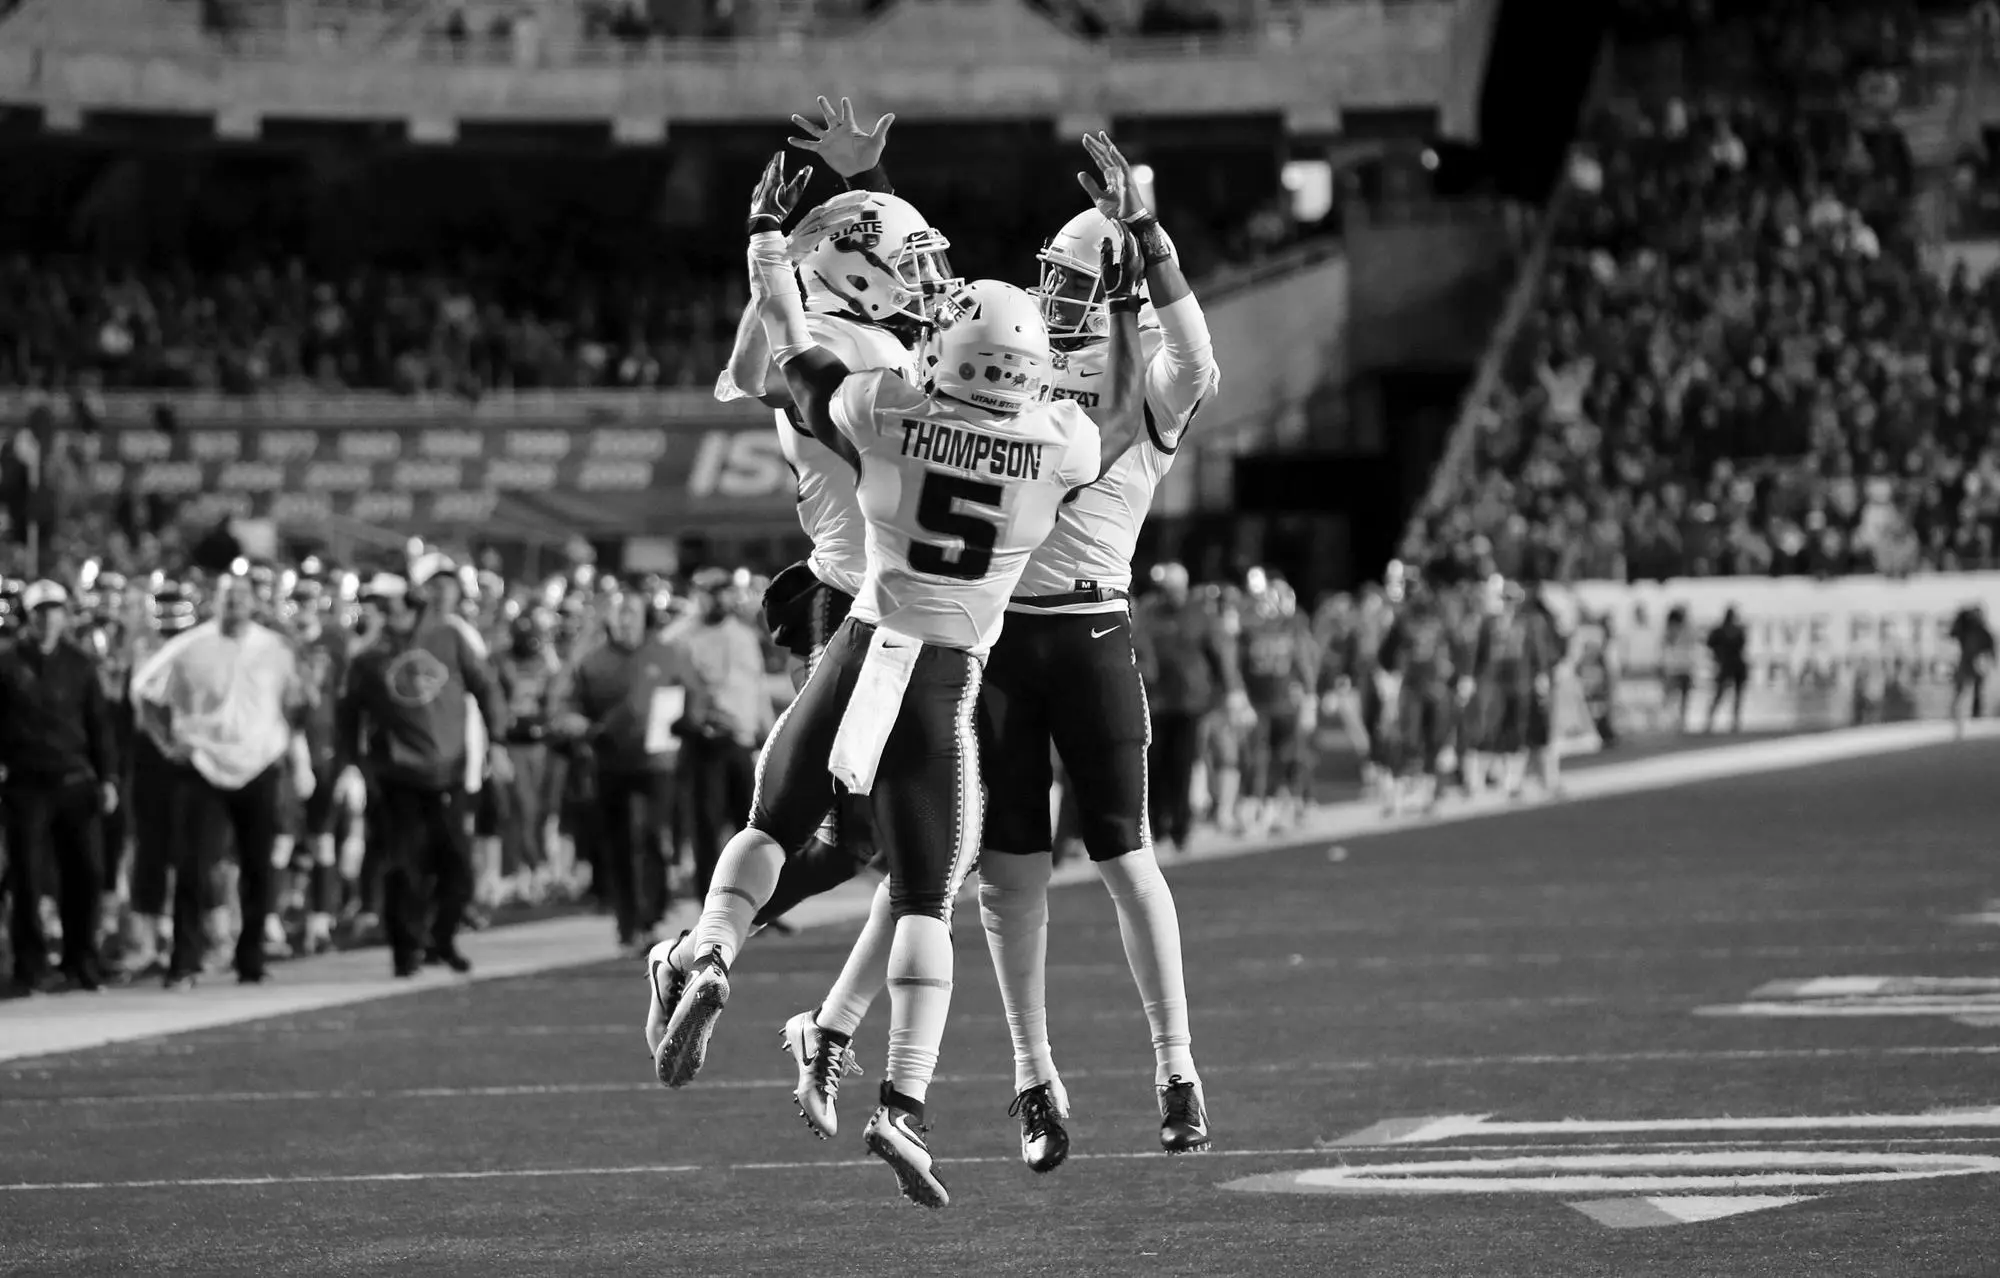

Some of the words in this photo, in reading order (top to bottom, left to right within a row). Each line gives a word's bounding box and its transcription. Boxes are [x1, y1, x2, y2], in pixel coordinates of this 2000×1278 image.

[970, 393, 997, 406] UTAH
[1051, 387, 1100, 408] STAT
[688, 430, 798, 498] IS
[901, 418, 1043, 480] THOMPSON
[907, 472, 1005, 571] 5
[1081, 581, 1091, 589] M
